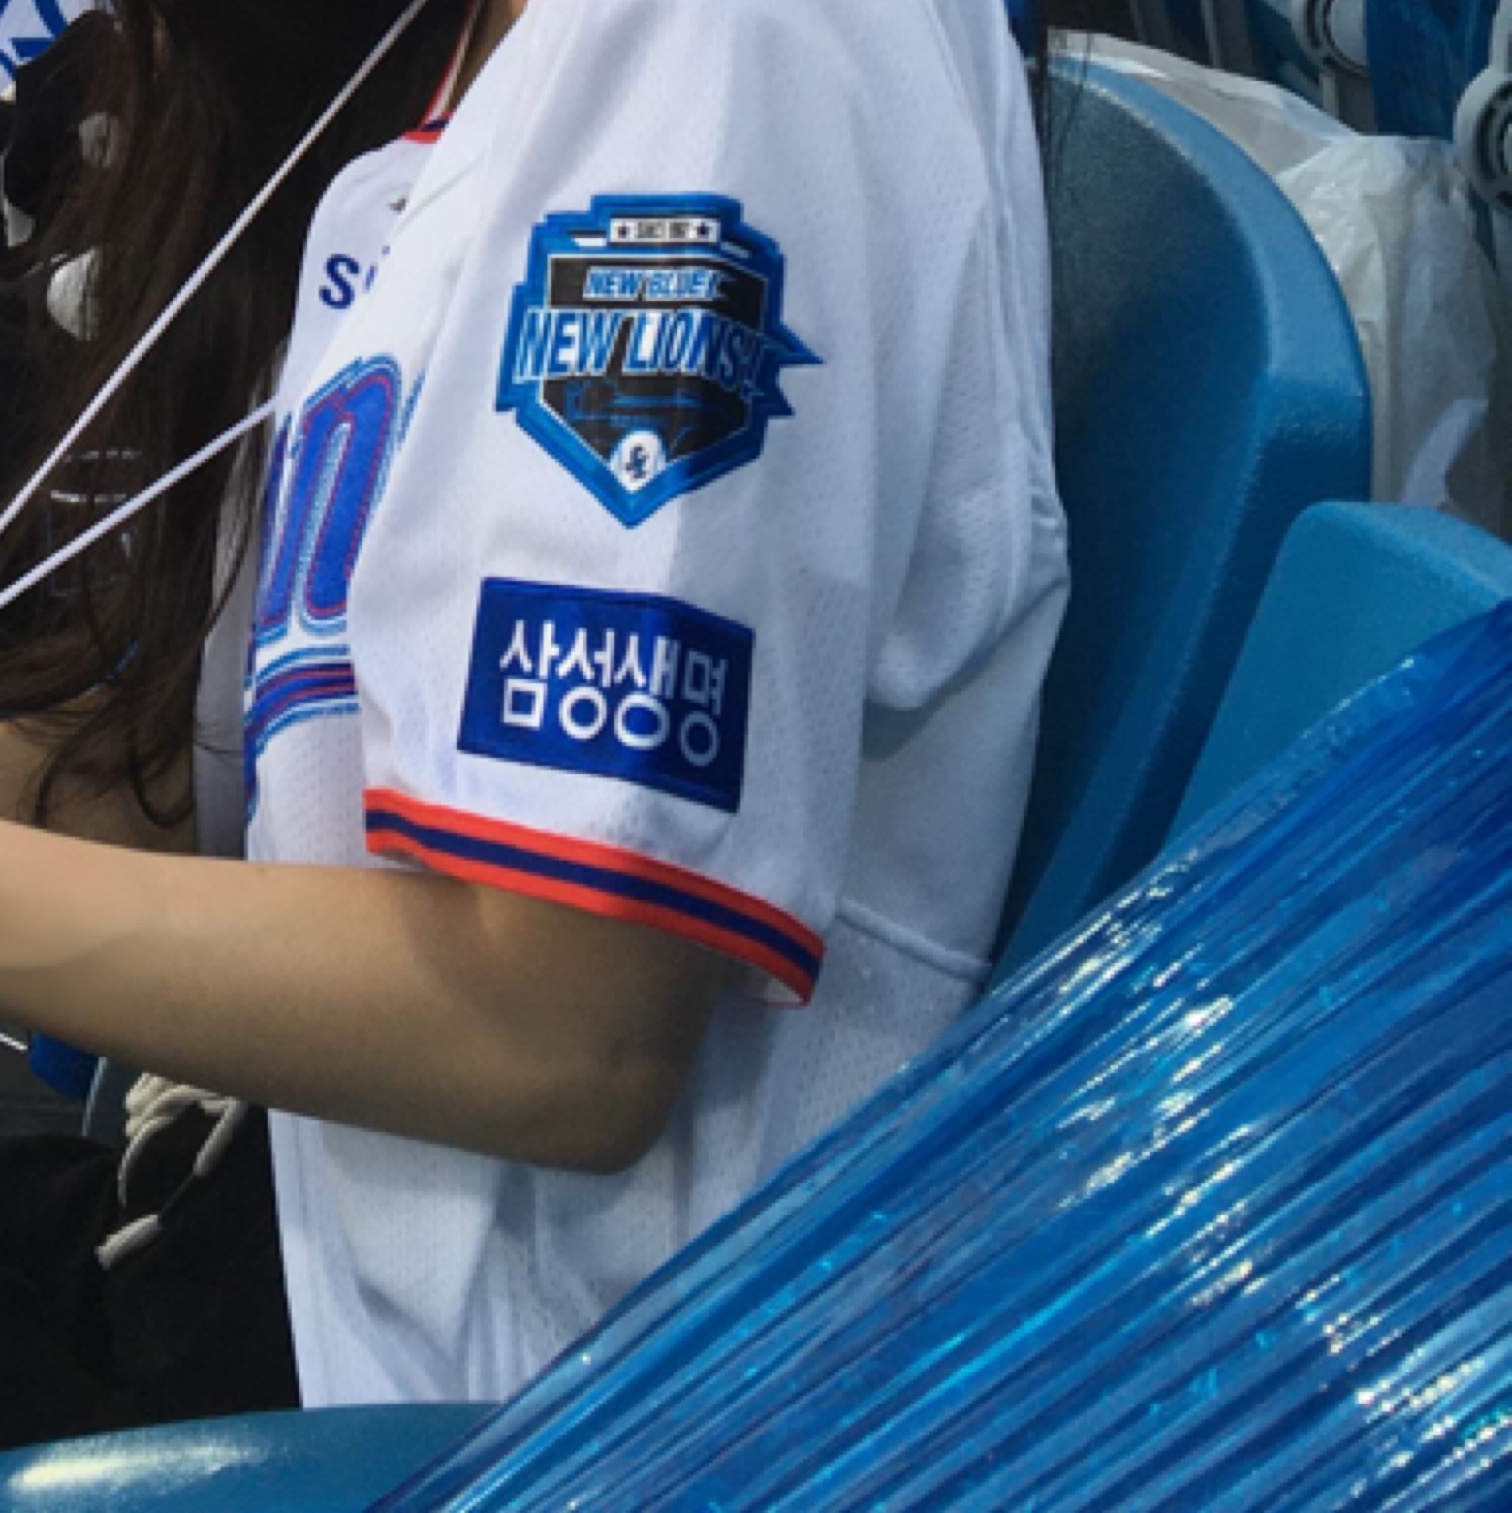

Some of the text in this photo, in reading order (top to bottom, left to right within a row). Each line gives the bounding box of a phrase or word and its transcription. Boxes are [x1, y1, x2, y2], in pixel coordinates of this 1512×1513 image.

[583, 265, 642, 301] NEW
[511, 307, 627, 385] NEW
[499, 618, 729, 767] 삼성생명
